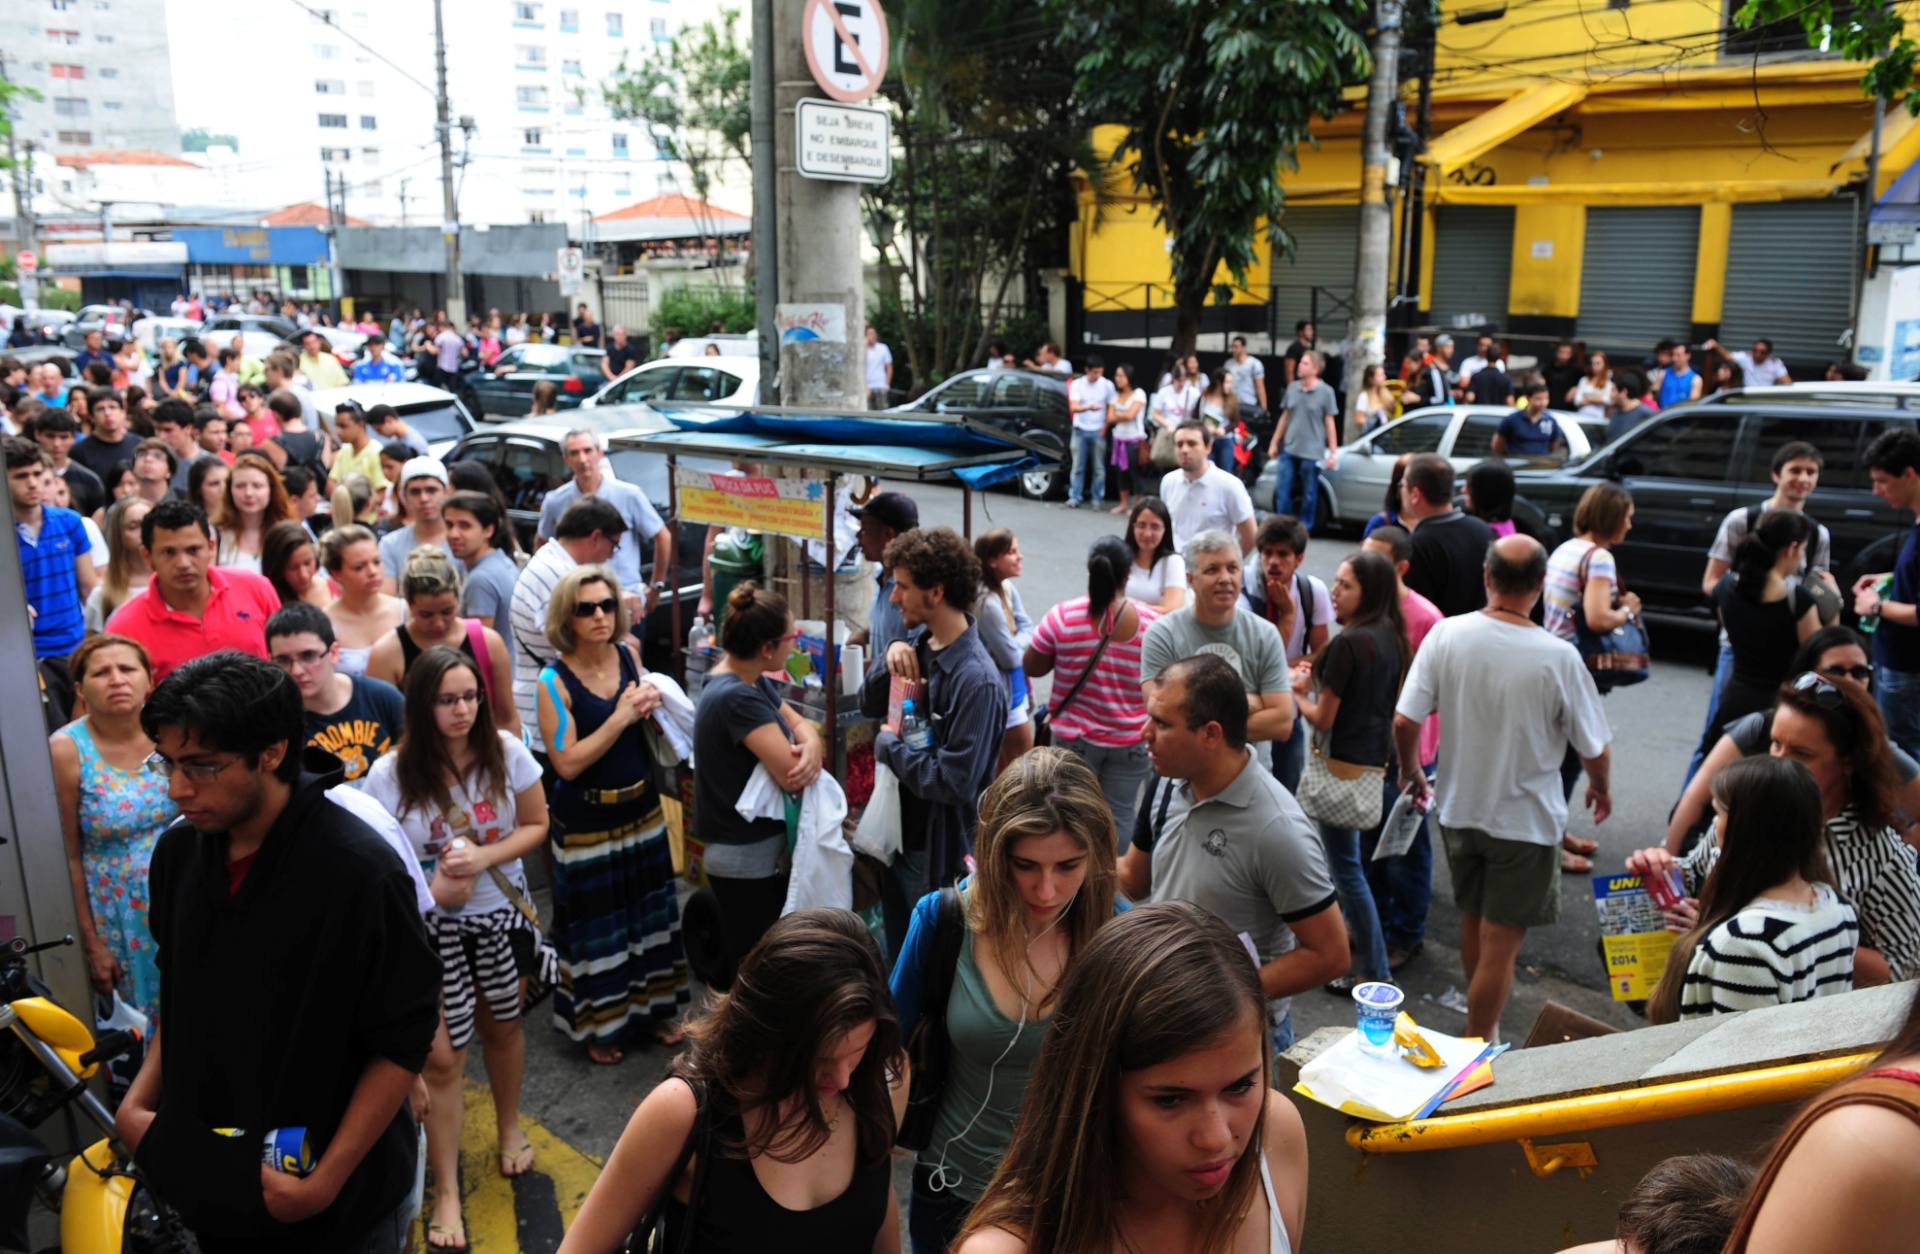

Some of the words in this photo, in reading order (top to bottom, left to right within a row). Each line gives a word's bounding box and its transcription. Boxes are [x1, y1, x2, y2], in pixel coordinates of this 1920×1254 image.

[834, 2, 863, 77] E
[816, 115, 840, 128] SEJA
[846, 118, 875, 131] BREVE
[810, 134, 825, 144] NO
[829, 135, 878, 149] EMBARQUE
[806, 152, 812, 162] E
[816, 152, 883, 168] DESEMBARQUE
[754, 482, 775, 495] PUC
[1611, 955, 1638, 966] 2014
